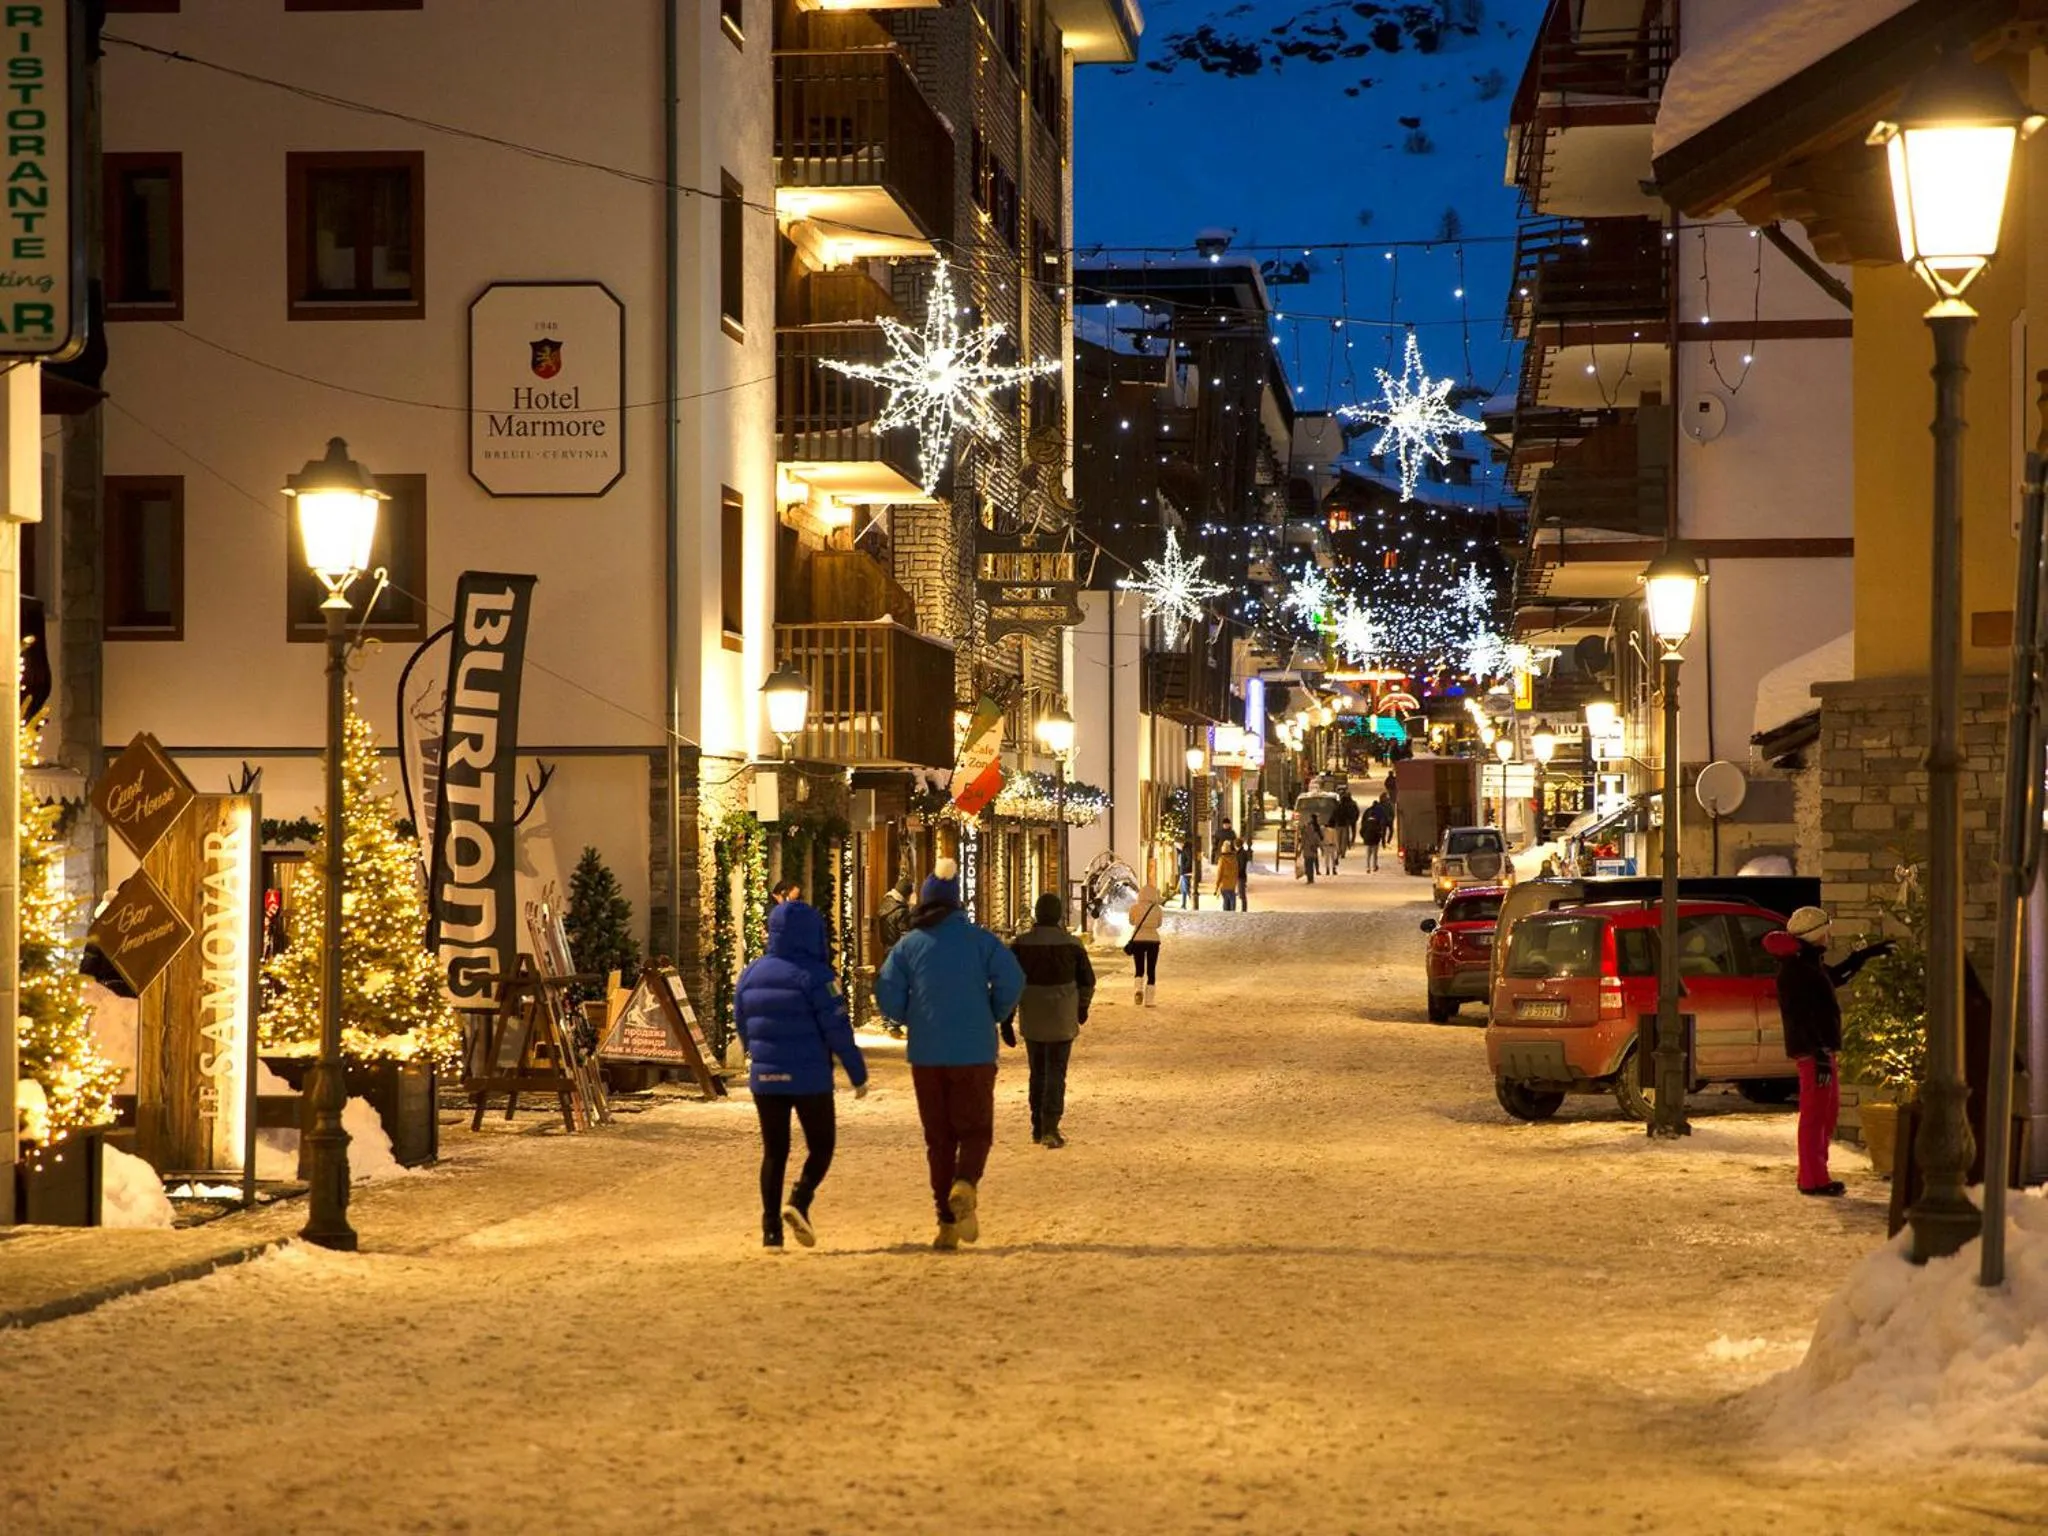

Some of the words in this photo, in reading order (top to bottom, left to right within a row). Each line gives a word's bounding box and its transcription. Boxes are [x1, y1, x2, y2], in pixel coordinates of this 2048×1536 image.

[6, 5, 48, 259] RISTORANTE
[513, 386, 580, 410] Hotel
[488, 414, 606, 437] Marmore
[440, 587, 516, 942] BURTON
[119, 786, 175, 823] House
[102, 903, 153, 933] Bar
[200, 828, 241, 1079] SAMOVAR
[199, 1085, 219, 1120] LE
